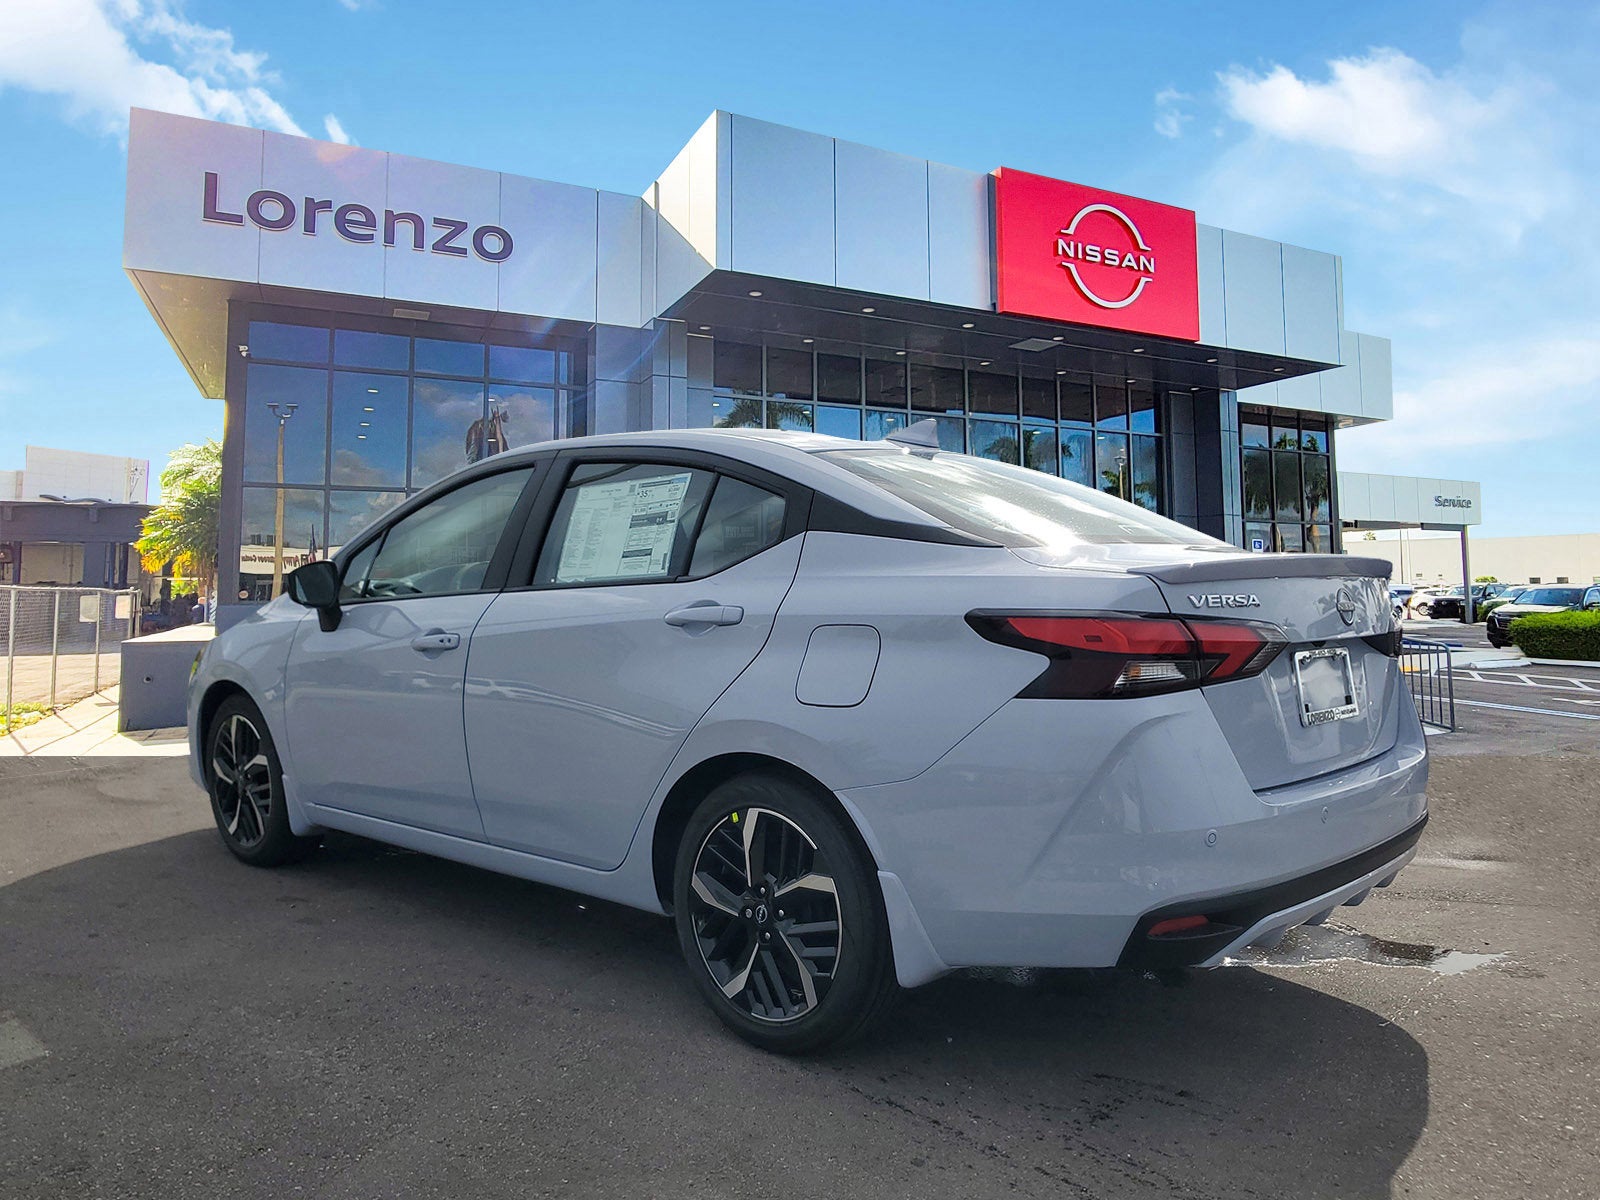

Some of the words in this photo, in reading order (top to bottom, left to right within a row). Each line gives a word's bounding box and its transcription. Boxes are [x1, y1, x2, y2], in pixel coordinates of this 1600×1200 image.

[202, 171, 514, 262] Lorenzo
[1056, 238, 1155, 273] NISSAN
[1434, 495, 1472, 509] Service
[1187, 593, 1261, 608] VERSA
[1307, 709, 1335, 726] LORENZO
